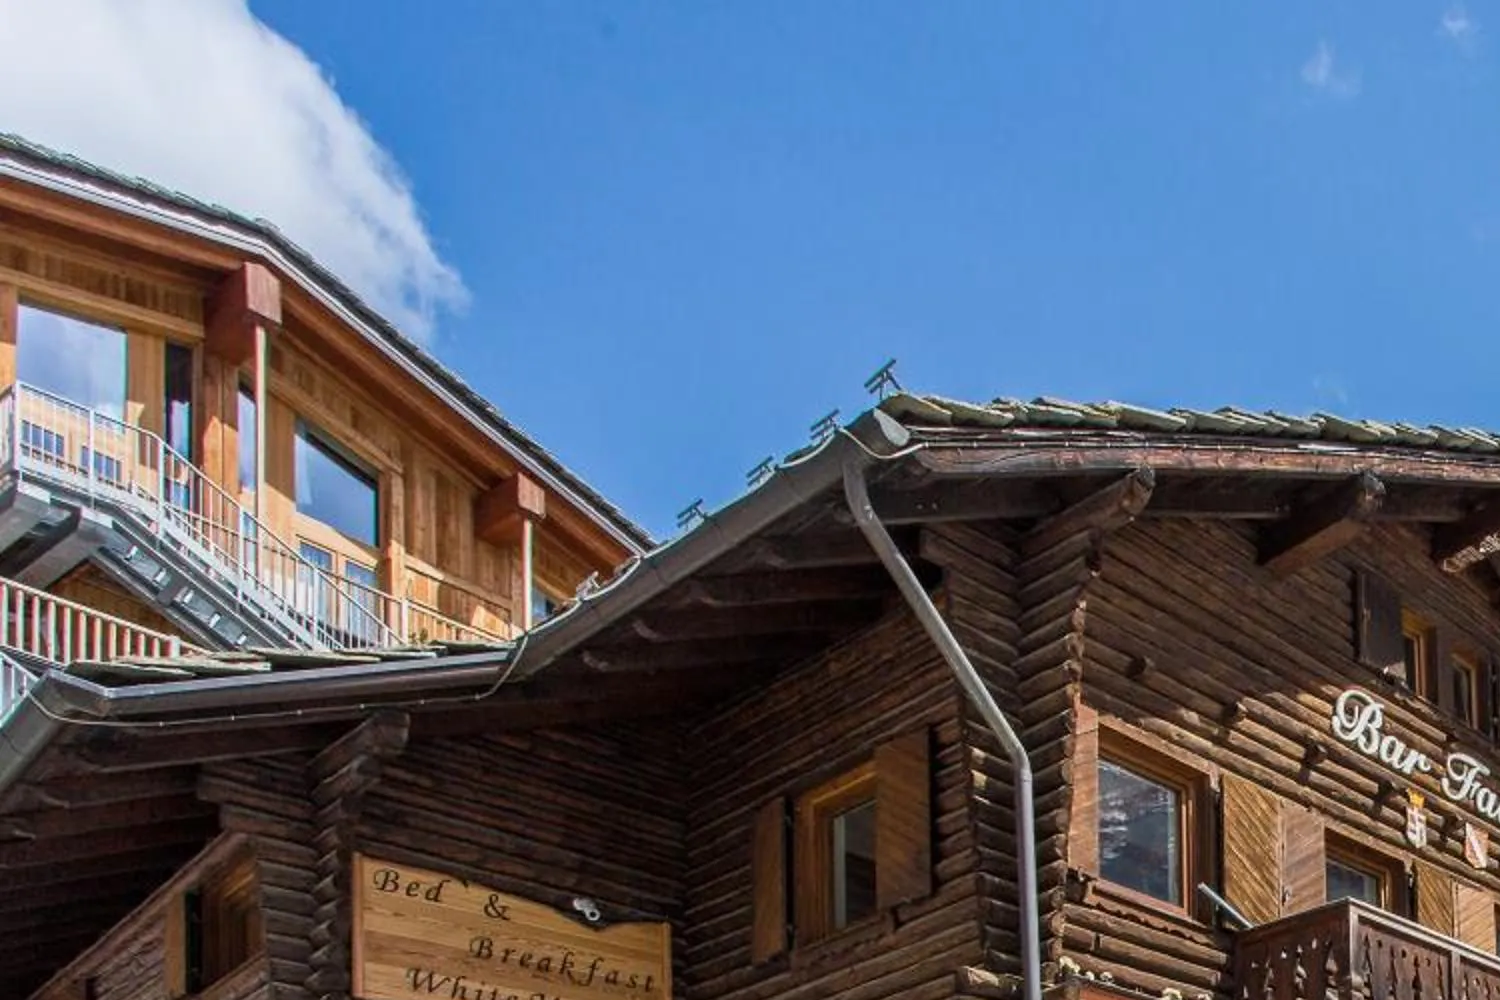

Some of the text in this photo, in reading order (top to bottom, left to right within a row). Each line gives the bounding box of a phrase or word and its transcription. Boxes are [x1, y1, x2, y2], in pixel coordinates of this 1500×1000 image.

[1332, 689, 1432, 775] Bar
[373, 867, 512, 921] Bed &
[469, 935, 656, 993] Breakfast
